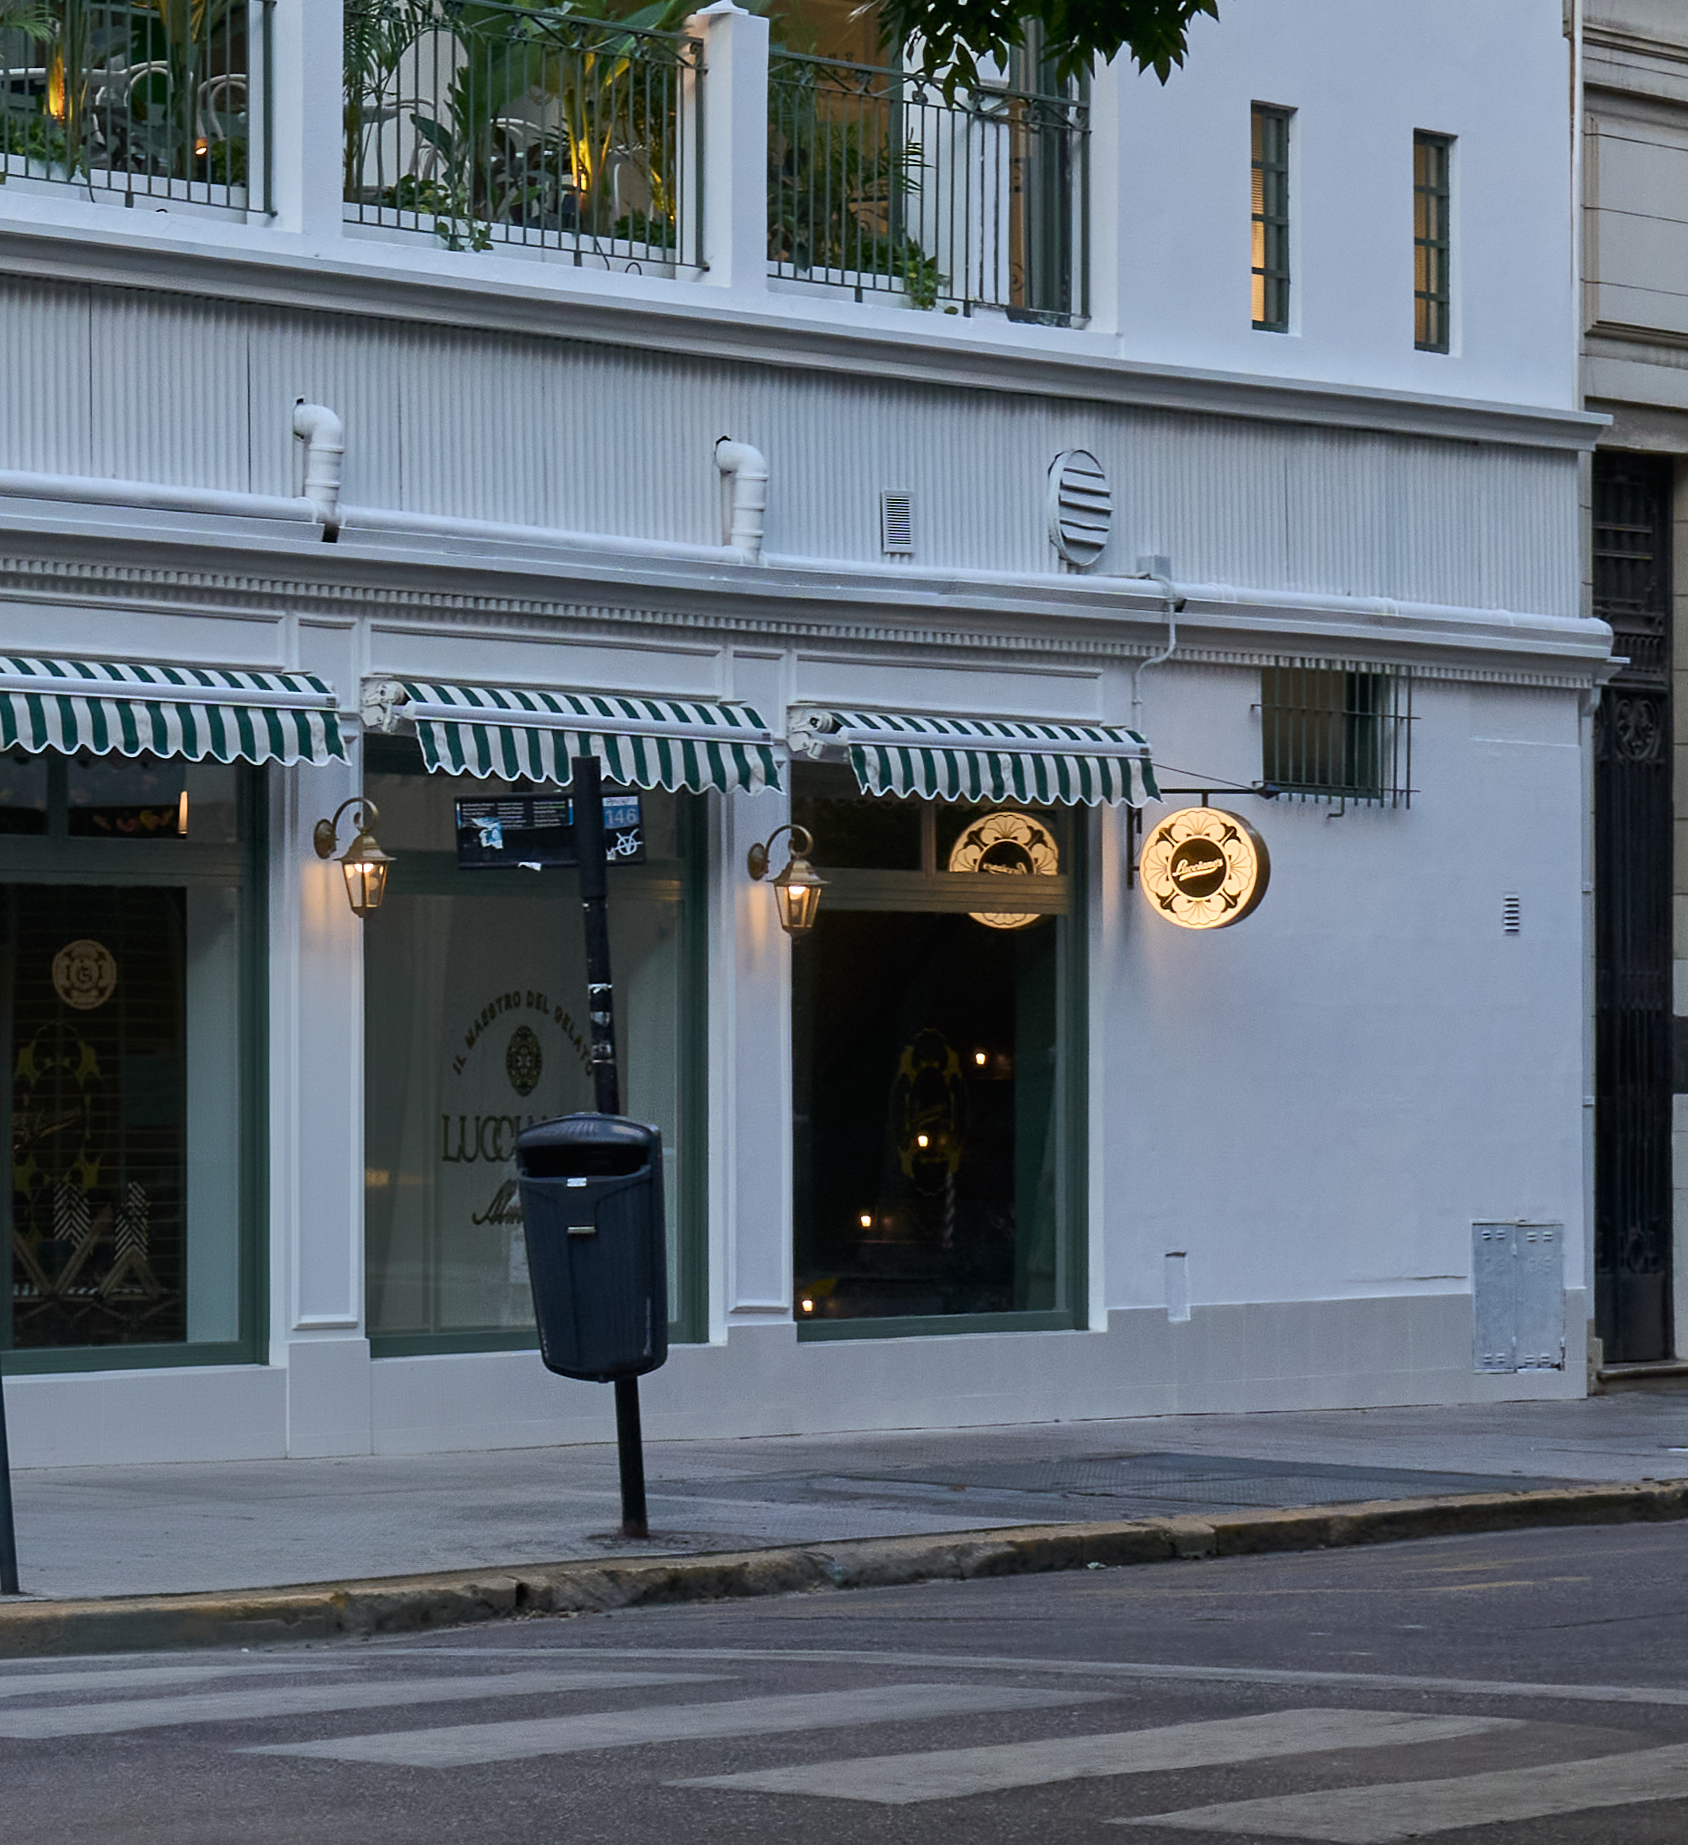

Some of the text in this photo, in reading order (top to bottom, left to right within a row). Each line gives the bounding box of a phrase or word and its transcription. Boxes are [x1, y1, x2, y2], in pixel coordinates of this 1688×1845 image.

[605, 808, 637, 824] 146
[465, 990, 521, 1050] MAESTRO
[526, 990, 549, 1015] DEL
